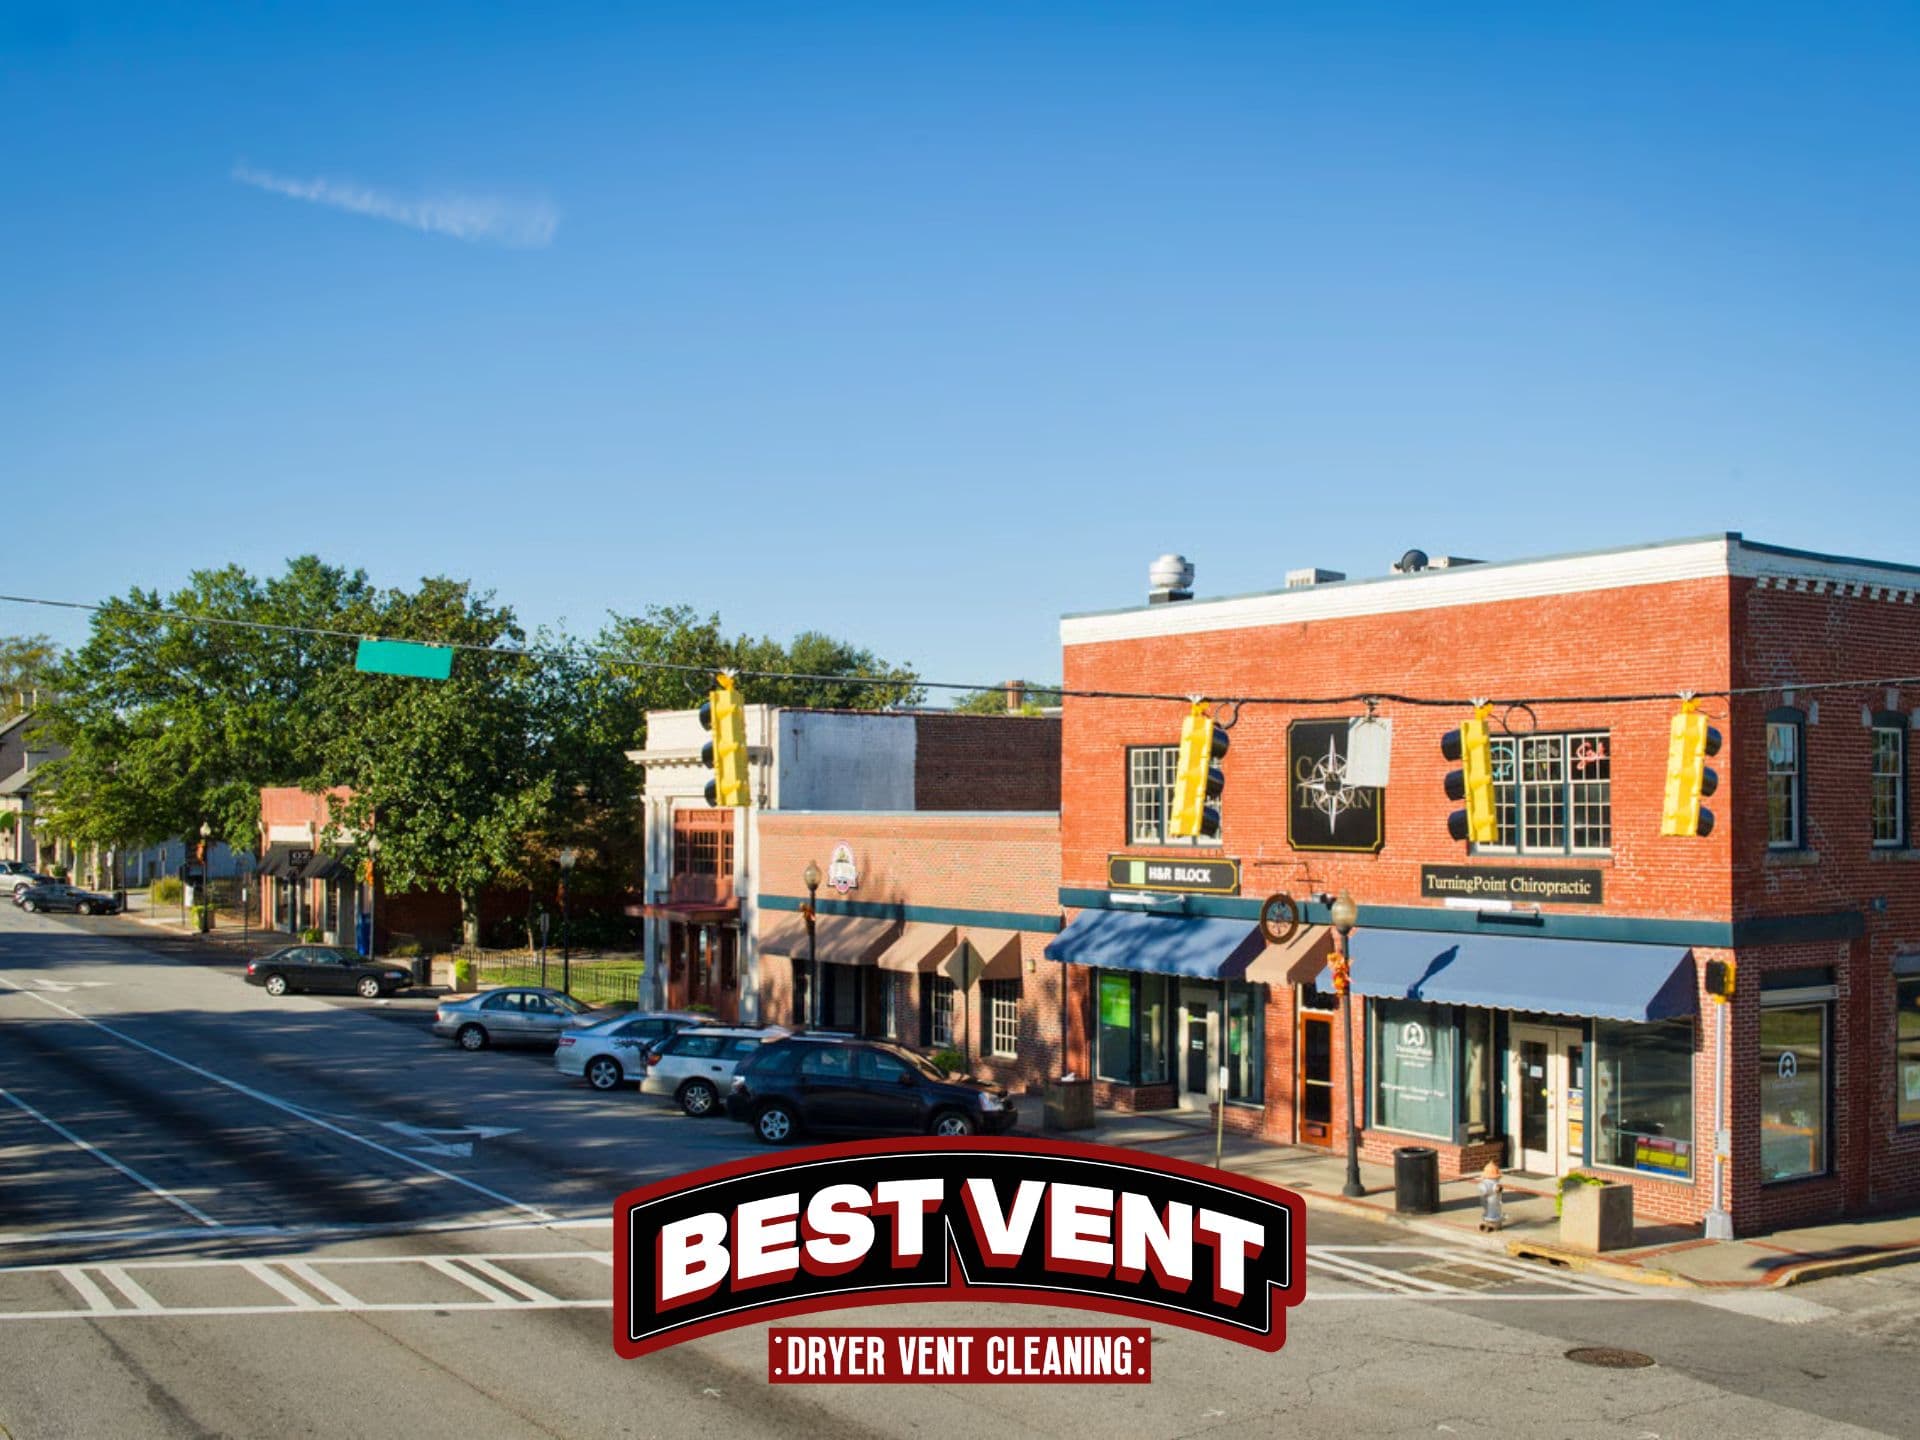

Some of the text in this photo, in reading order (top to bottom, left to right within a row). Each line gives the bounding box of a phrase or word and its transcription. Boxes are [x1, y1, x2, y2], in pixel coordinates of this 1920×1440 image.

[1148, 866, 1211, 883] H&R BLOCK
[1426, 874, 1591, 896] TurningPoint Chiropractic
